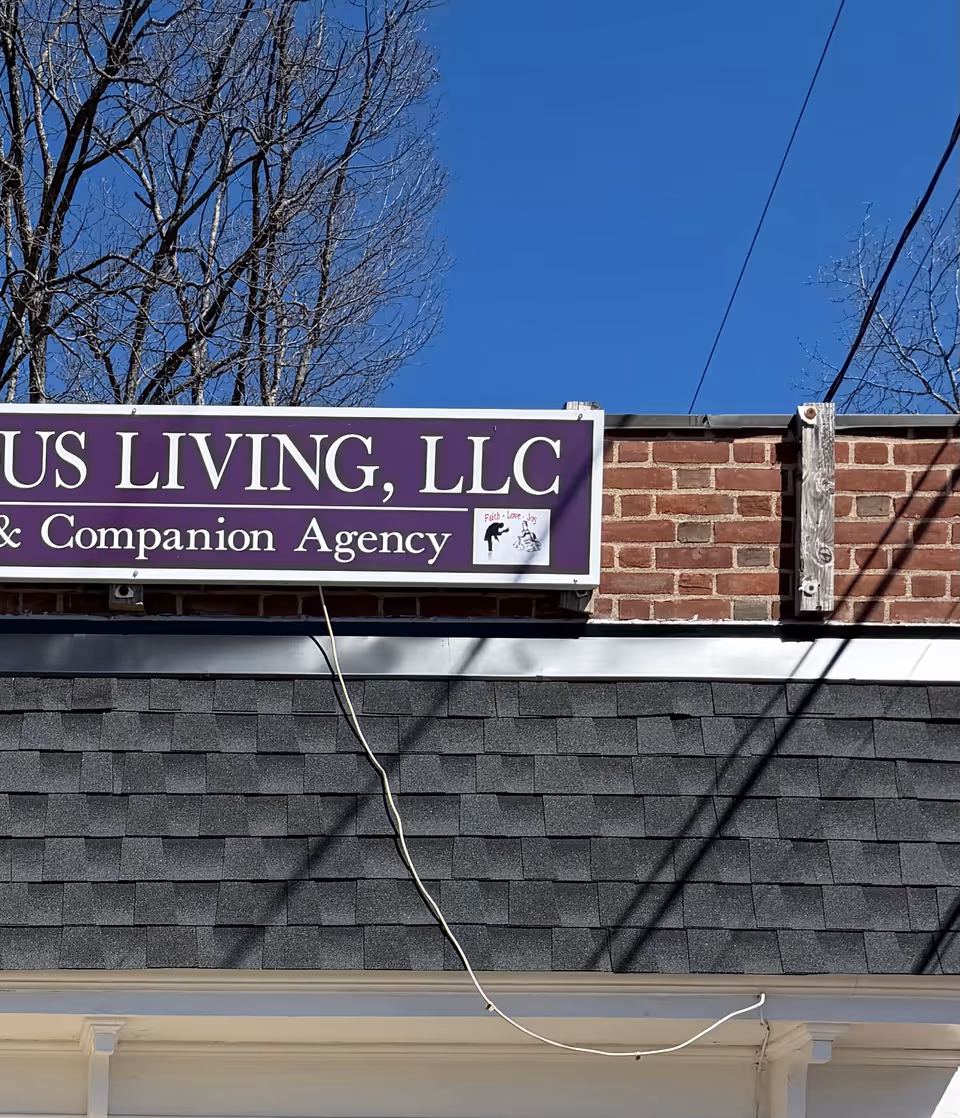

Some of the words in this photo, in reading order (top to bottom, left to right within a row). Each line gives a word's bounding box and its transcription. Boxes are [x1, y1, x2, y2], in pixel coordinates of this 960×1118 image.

[115, 431, 394, 503] LIVING,
[419, 435, 561, 496] LLC
[41, 513, 276, 560] Companion
[294, 517, 452, 565] Agency
[484, 511, 501, 522] Faith
[507, 510, 522, 520] Love
[527, 512, 538, 525] Joy
